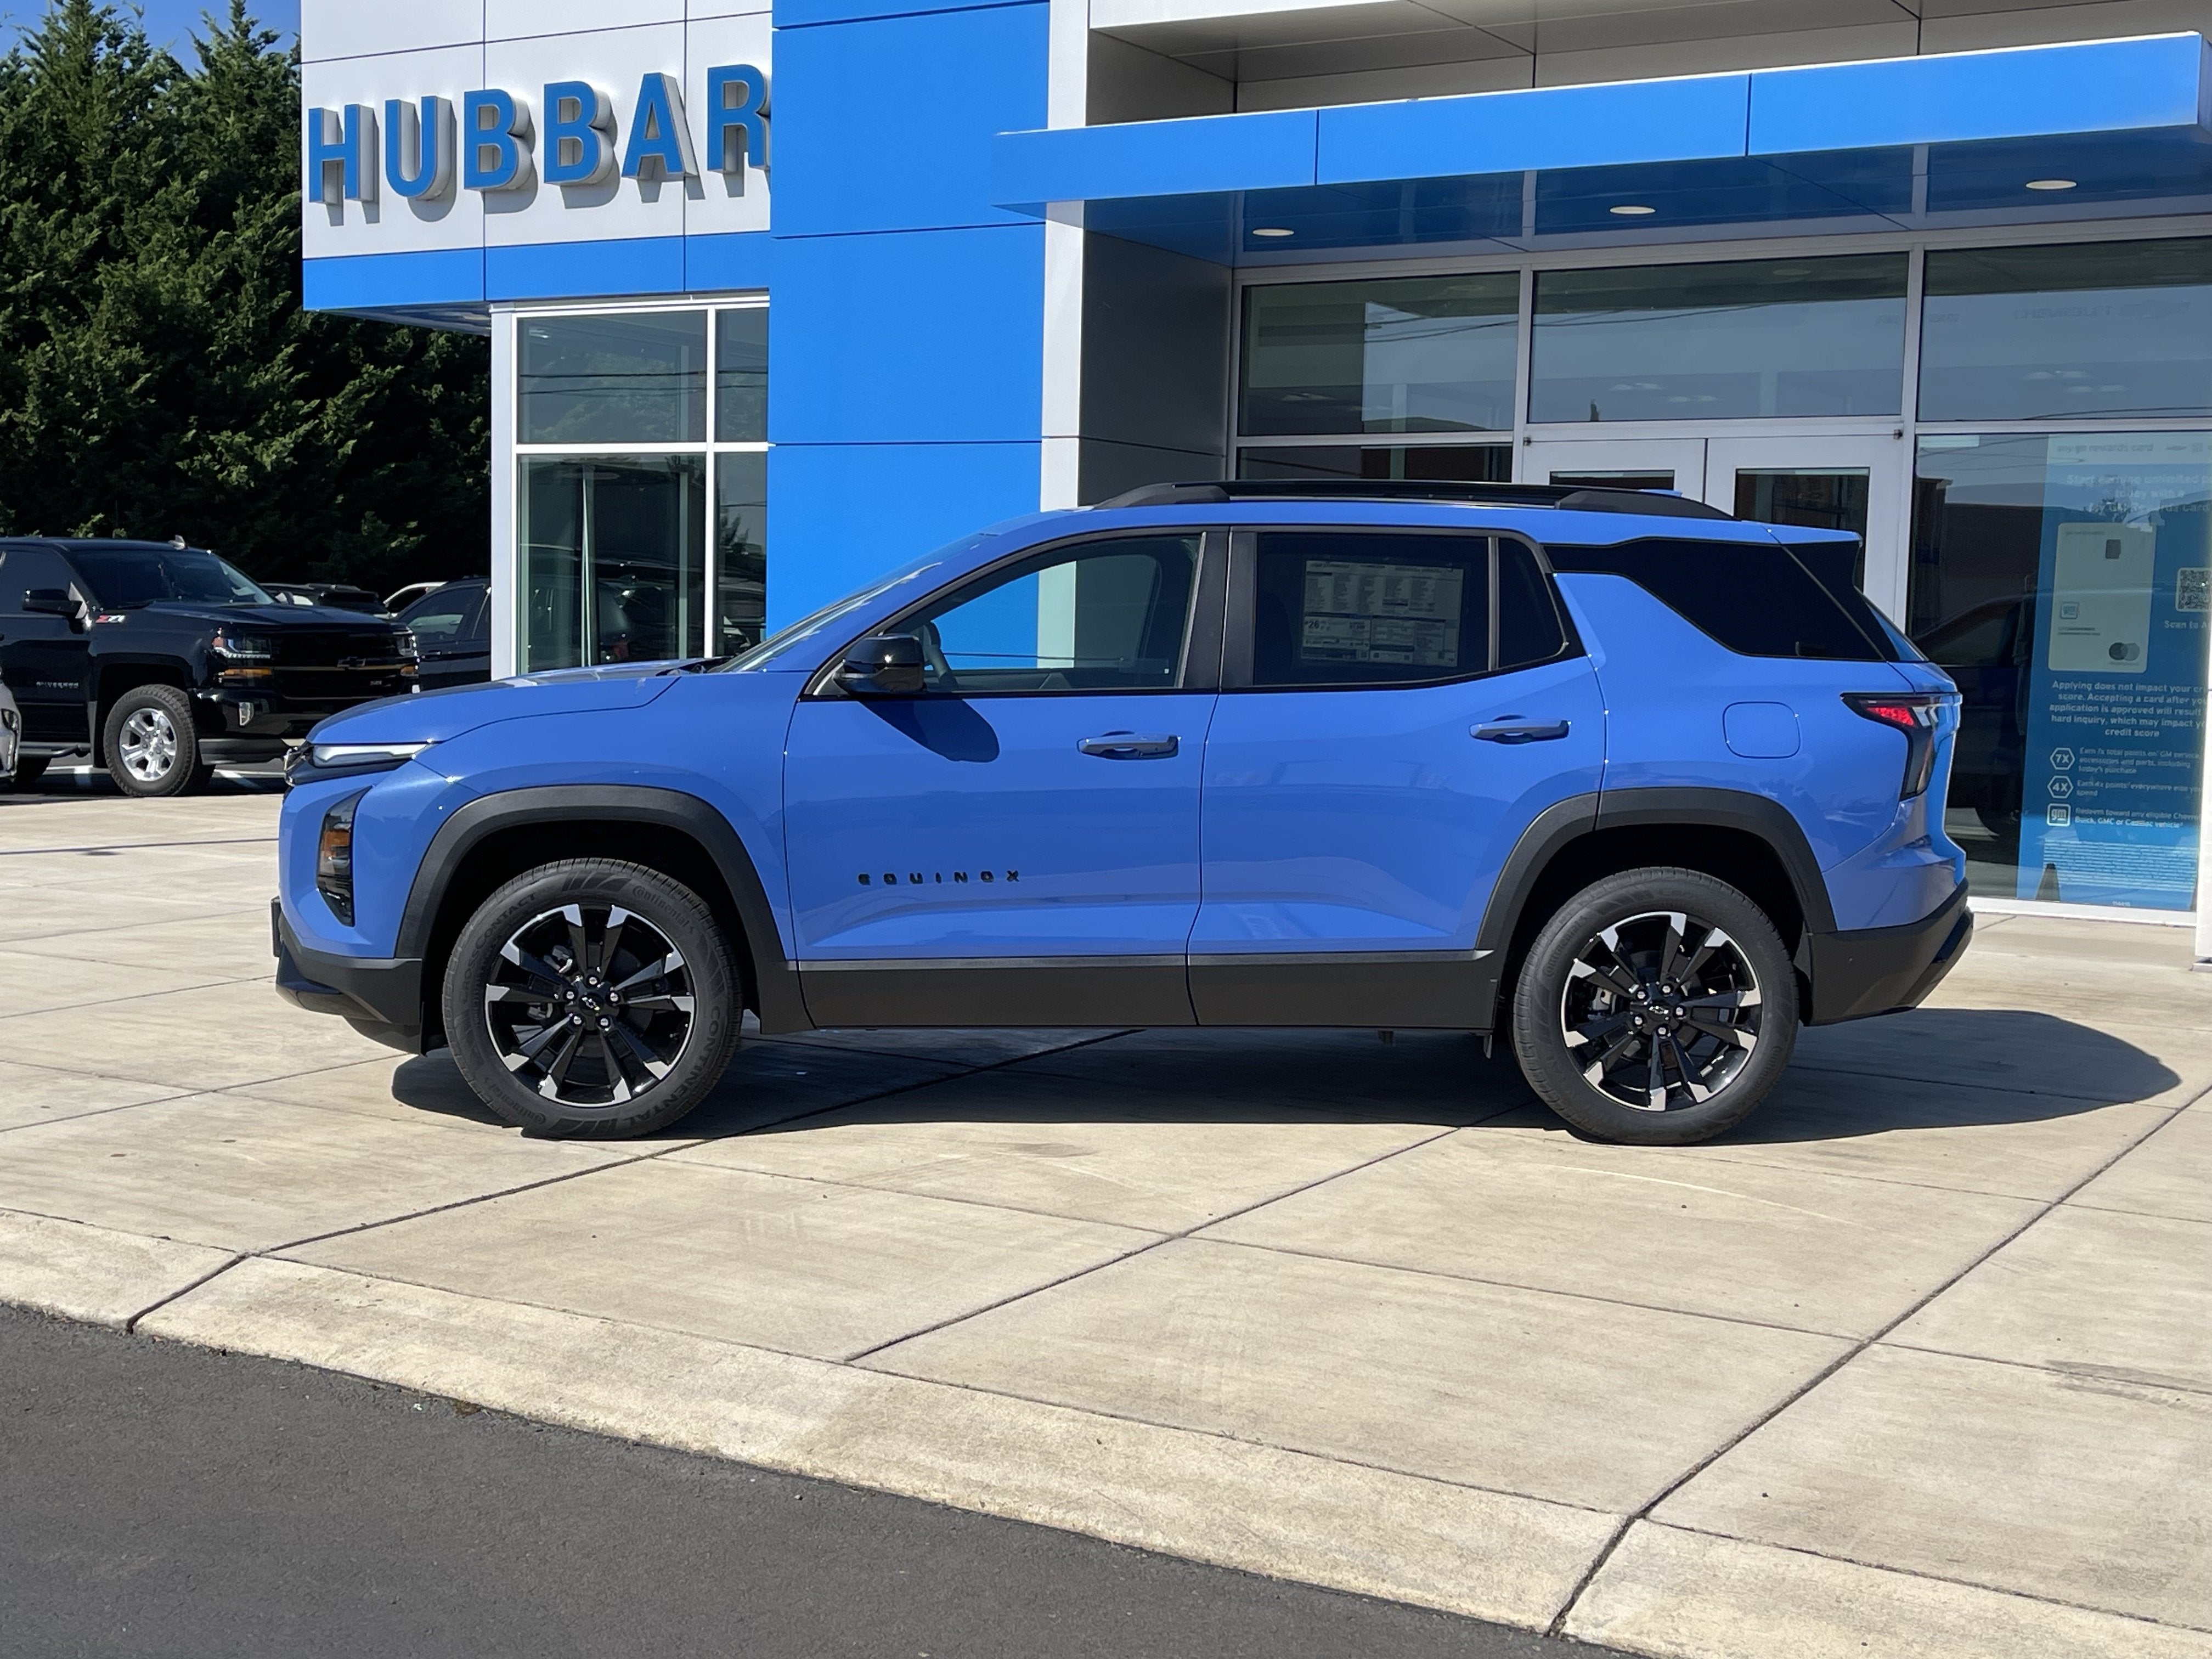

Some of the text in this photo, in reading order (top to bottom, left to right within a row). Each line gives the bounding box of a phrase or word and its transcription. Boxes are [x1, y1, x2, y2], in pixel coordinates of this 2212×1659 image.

[308, 64, 770, 204] HUBBAR
[95, 614, 126, 624] Z71
[2164, 620, 2187, 629] Scan
[2053, 680, 2092, 691] Applying
[2094, 682, 2116, 690] does
[2135, 683, 2168, 692] impact
[2169, 685, 2191, 693] your
[2087, 693, 2134, 704] Accepting
[2049, 704, 2100, 713] application
[2101, 704, 2109, 713] is
[2111, 707, 2154, 715] approved
[2156, 707, 2172, 715] will
[2074, 715, 2107, 725] inquiry,
[2110, 716, 2137, 725] which
[2140, 719, 2159, 728] may
[2162, 718, 2193, 728] impact
[2055, 754, 2070, 764] 7X
[2052, 783, 2068, 792] 4X
[858, 870, 1019, 885] EQUINOX
[632, 885, 690, 928] Continental
